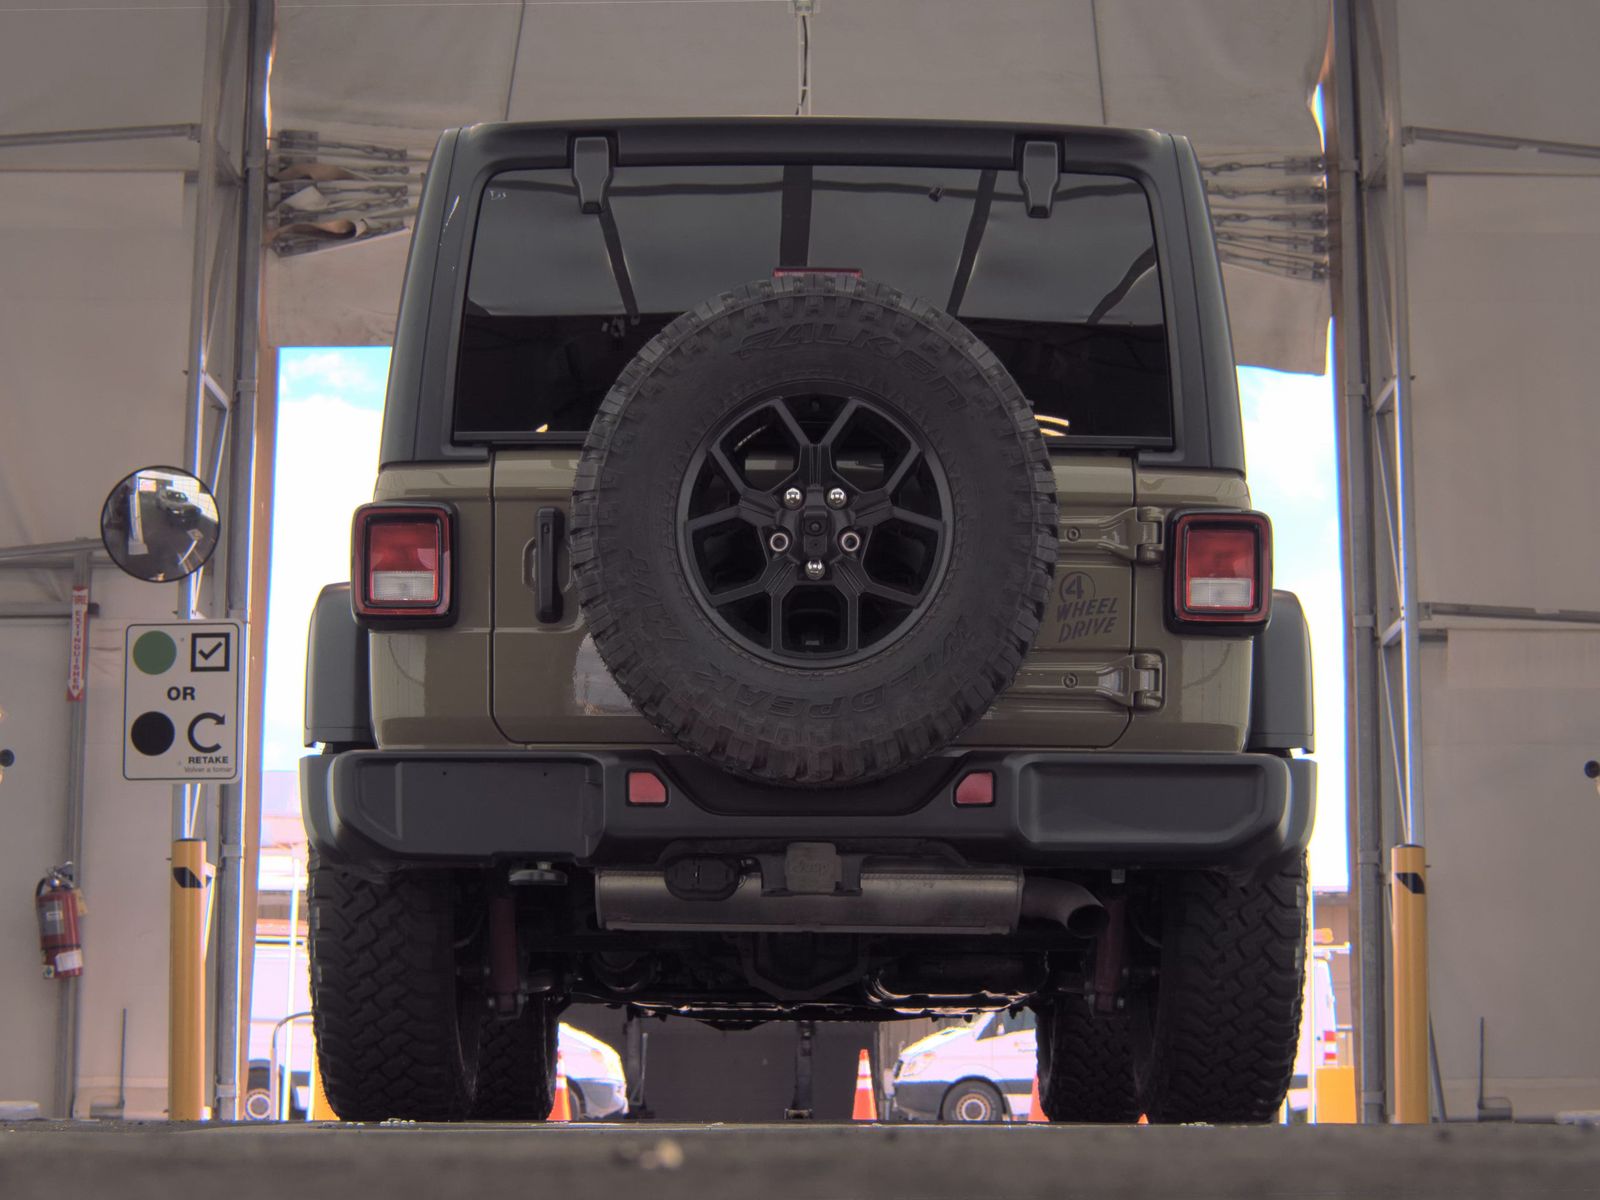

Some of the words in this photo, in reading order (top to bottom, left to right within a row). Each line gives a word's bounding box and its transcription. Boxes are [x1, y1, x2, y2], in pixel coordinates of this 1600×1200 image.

[1064, 575, 1085, 600] 4
[1057, 597, 1118, 622] WHEEL
[1058, 616, 1118, 643] DRIVE
[166, 686, 196, 701] OR
[187, 756, 229, 764] RETAKE
